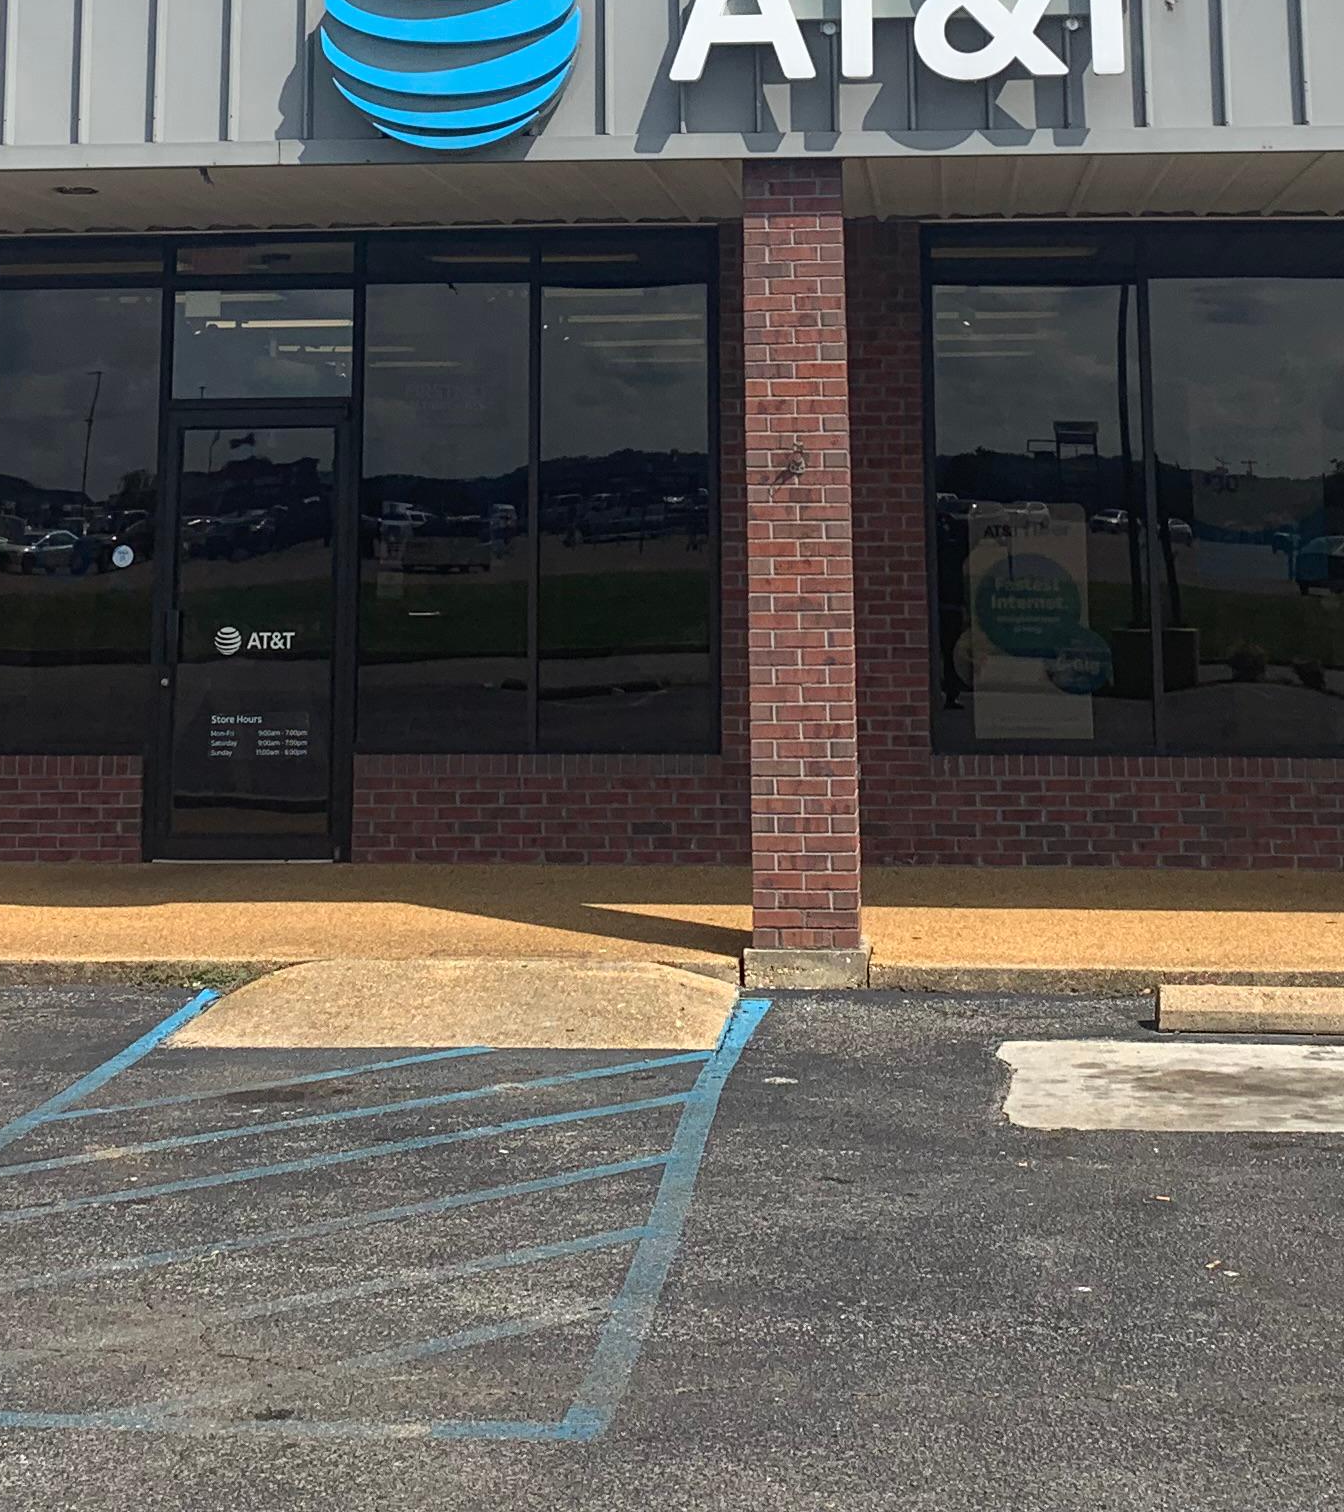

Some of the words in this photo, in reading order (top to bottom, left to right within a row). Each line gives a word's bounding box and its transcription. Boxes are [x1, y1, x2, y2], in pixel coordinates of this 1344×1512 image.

[246, 632, 296, 650] AT&T
[211, 715, 235, 724] Store
[236, 715, 263, 724] Hours
